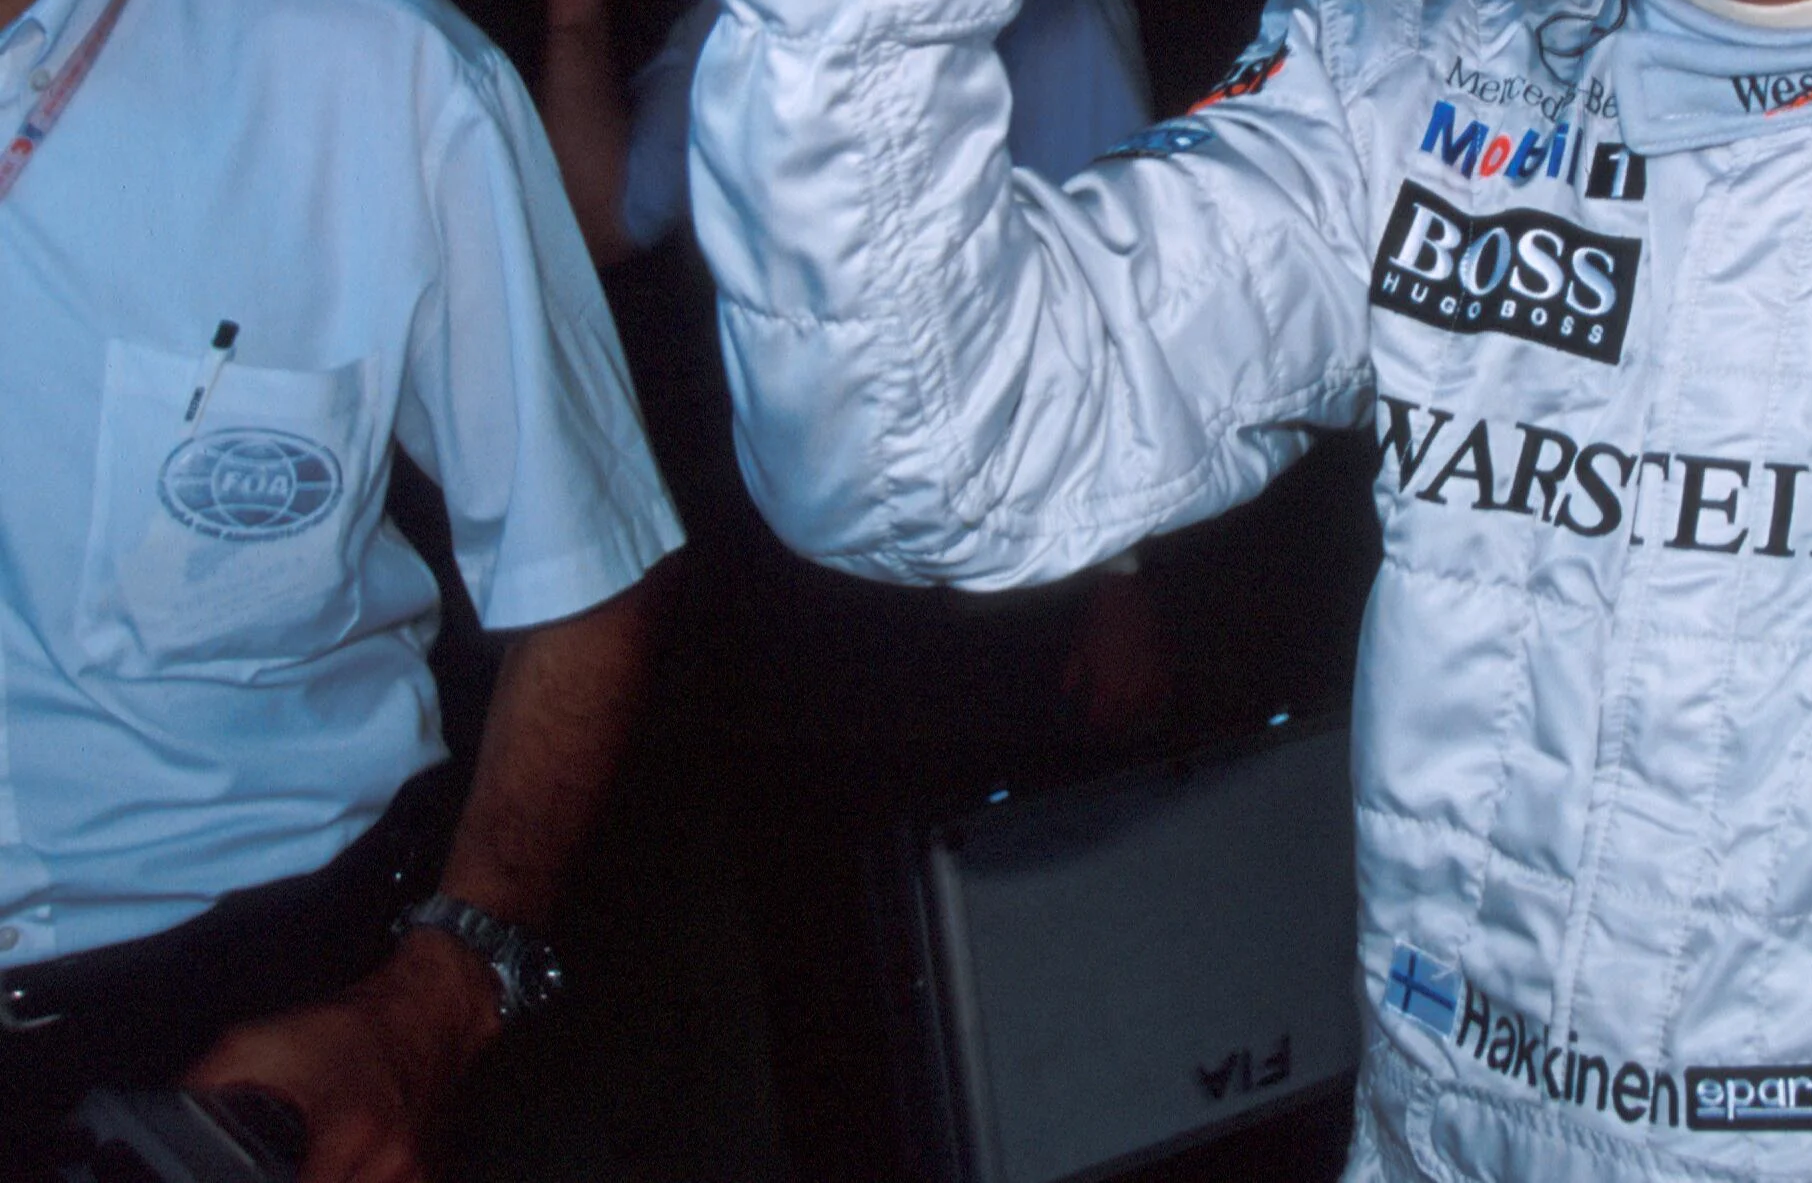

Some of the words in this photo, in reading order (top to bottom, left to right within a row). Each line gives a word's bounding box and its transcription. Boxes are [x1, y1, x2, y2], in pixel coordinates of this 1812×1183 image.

[1421, 99, 1583, 188] Mobil
[1389, 202, 1617, 316] BOSS
[1382, 271, 1482, 319] HUGO
[1500, 300, 1604, 344] BOSS
[1197, 1033, 1291, 1100] FIA
[1456, 979, 1680, 1128] Hakkinen
